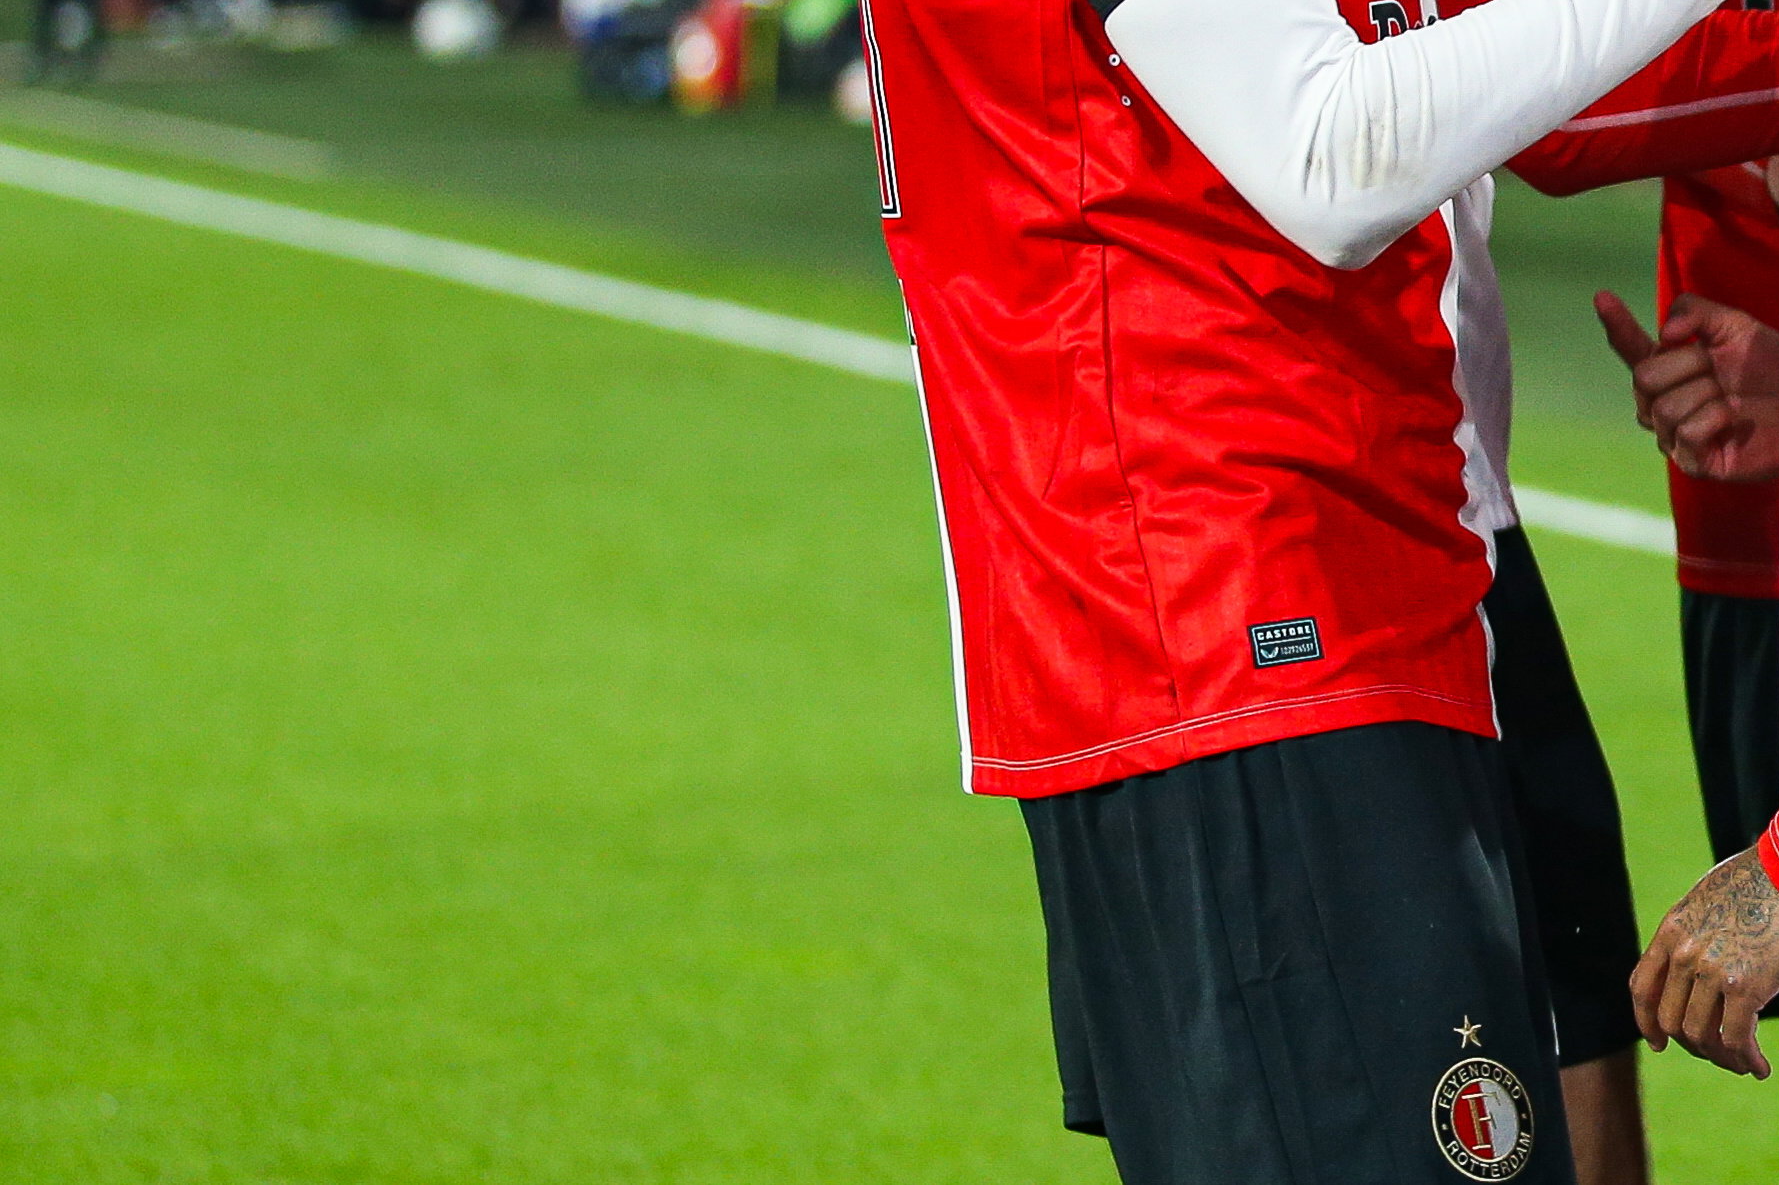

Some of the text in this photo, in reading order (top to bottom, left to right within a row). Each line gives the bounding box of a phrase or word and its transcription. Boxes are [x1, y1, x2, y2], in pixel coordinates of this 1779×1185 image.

[1257, 625, 1311, 641] CASTORE
[1438, 1064, 1522, 1109] FEYENOORD
[1446, 1132, 1531, 1178] ROTTERDAM
